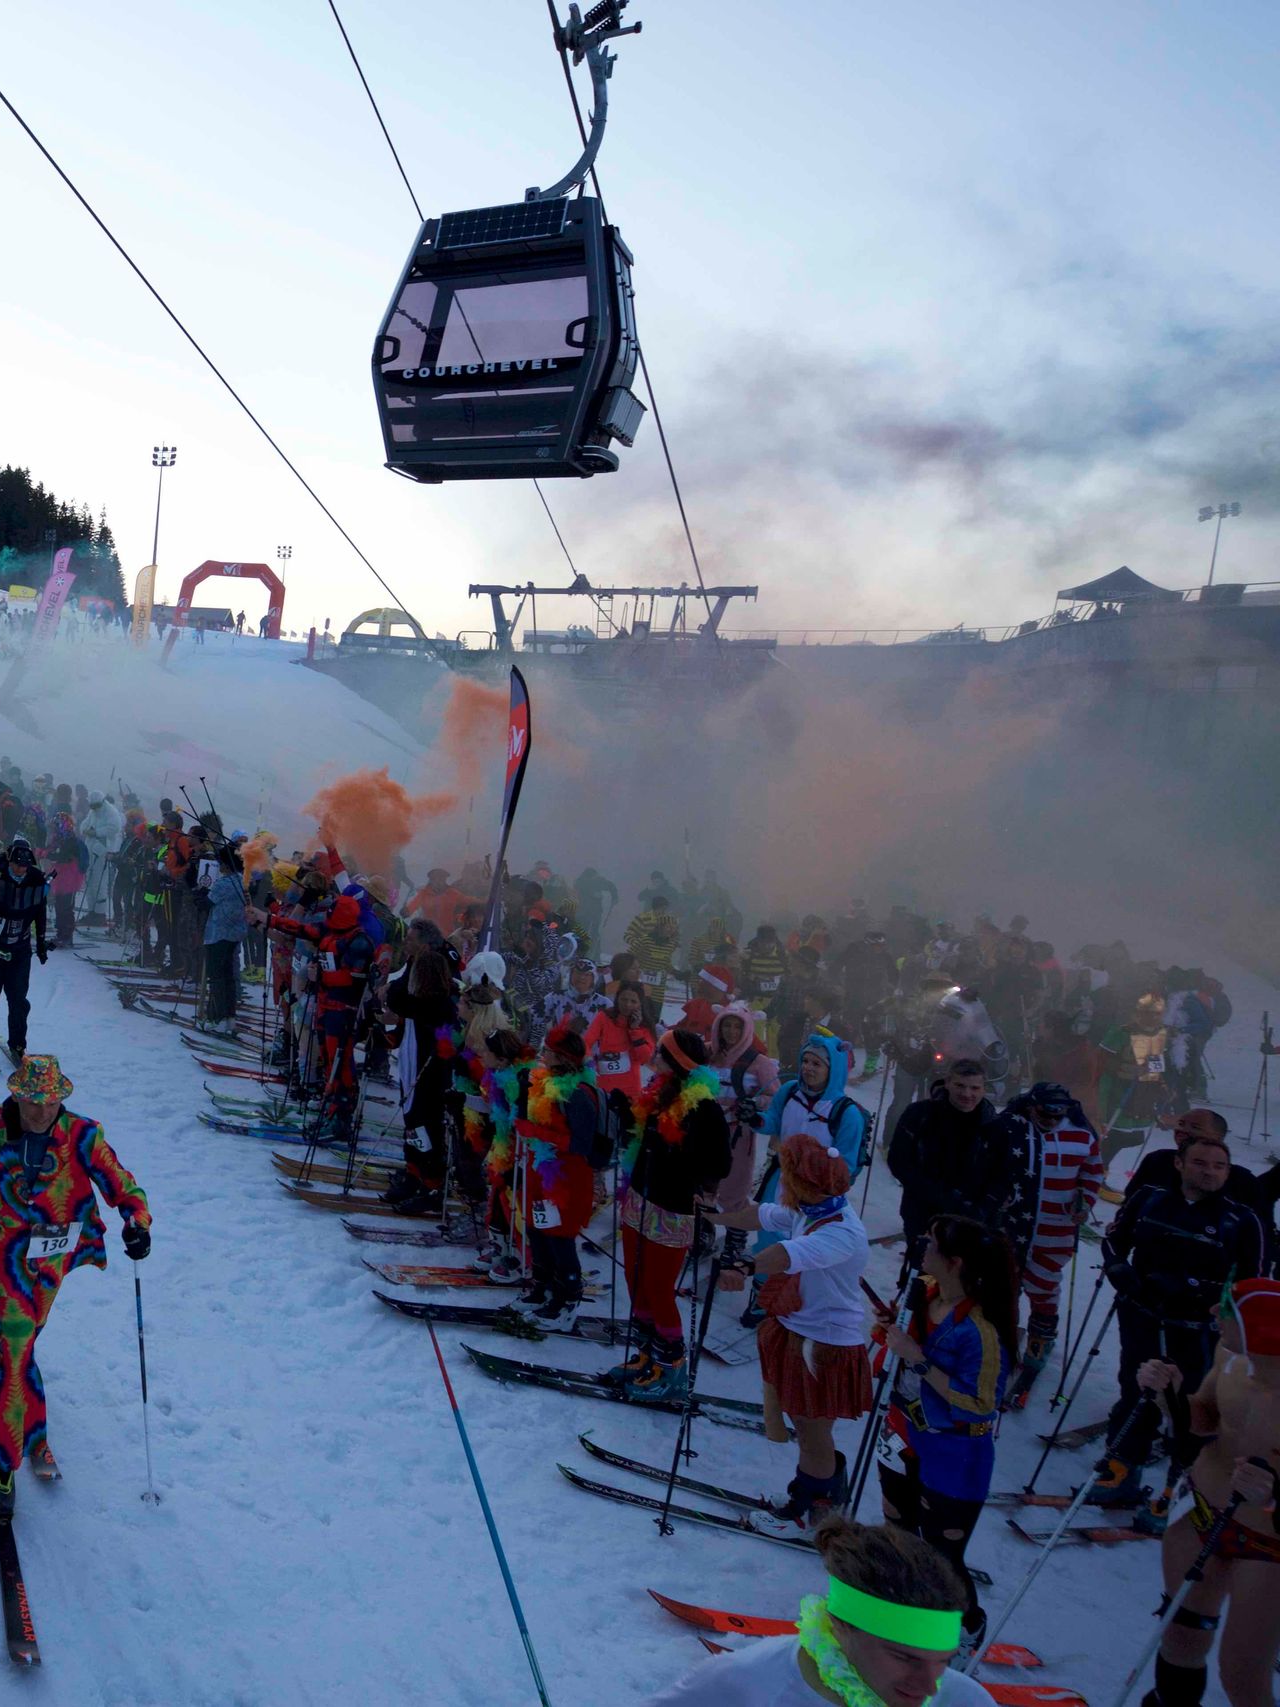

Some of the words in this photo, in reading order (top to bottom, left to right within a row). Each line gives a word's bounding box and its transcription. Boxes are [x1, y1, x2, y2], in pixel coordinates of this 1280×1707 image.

[402, 358, 558, 379] COURCHEVEL
[607, 1061, 621, 1071] 63
[42, 1238, 68, 1252] 130
[16, 1582, 37, 1642] DYNASTAR
